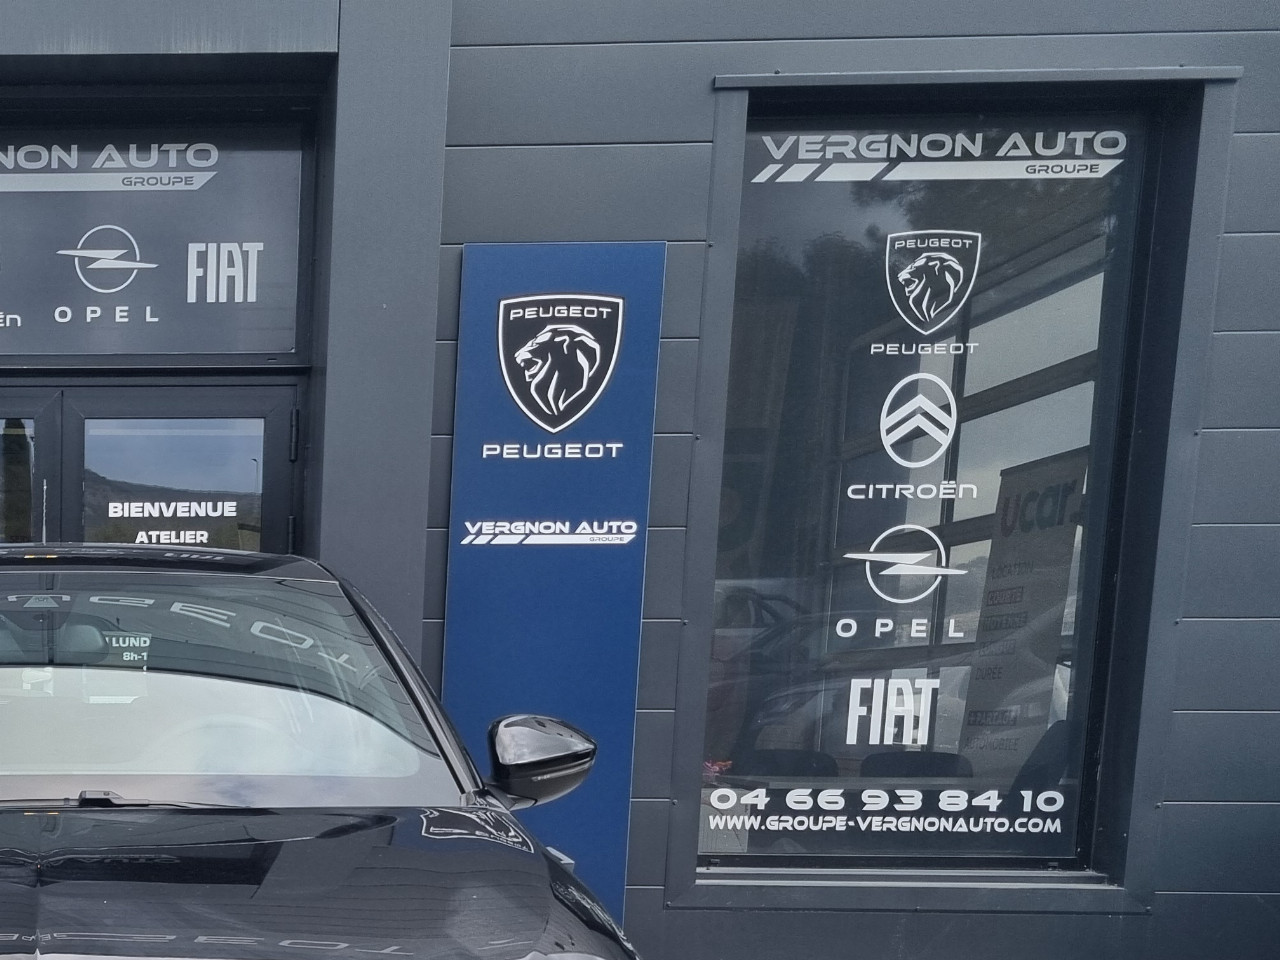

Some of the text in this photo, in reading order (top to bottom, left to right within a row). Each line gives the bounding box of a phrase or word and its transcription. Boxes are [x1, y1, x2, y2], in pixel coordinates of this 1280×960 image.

[761, 130, 1127, 160] VERGNON AUTO
[92, 142, 219, 169] AUTO
[1025, 162, 1100, 174] GROUPE
[121, 175, 195, 187] GROUPE
[894, 238, 974, 249] PEUGEOT
[187, 242, 264, 303] FIAT
[54, 306, 160, 323] OPEL
[509, 306, 613, 321] PEUGEOT
[870, 343, 980, 355] PEUGEOT
[482, 443, 624, 459] PEUGEOT
[108, 501, 238, 518] BIENVENUE
[464, 521, 637, 534] VERGNON AUTO
[135, 530, 209, 544] ATELIER
[836, 618, 964, 638] OPEL
[846, 678, 940, 745] FIAT
[710, 788, 1065, 812] 04 66 93 84 10
[709, 815, 1061, 833] WWW.GROUPE-VERGNONAUTO.COM
